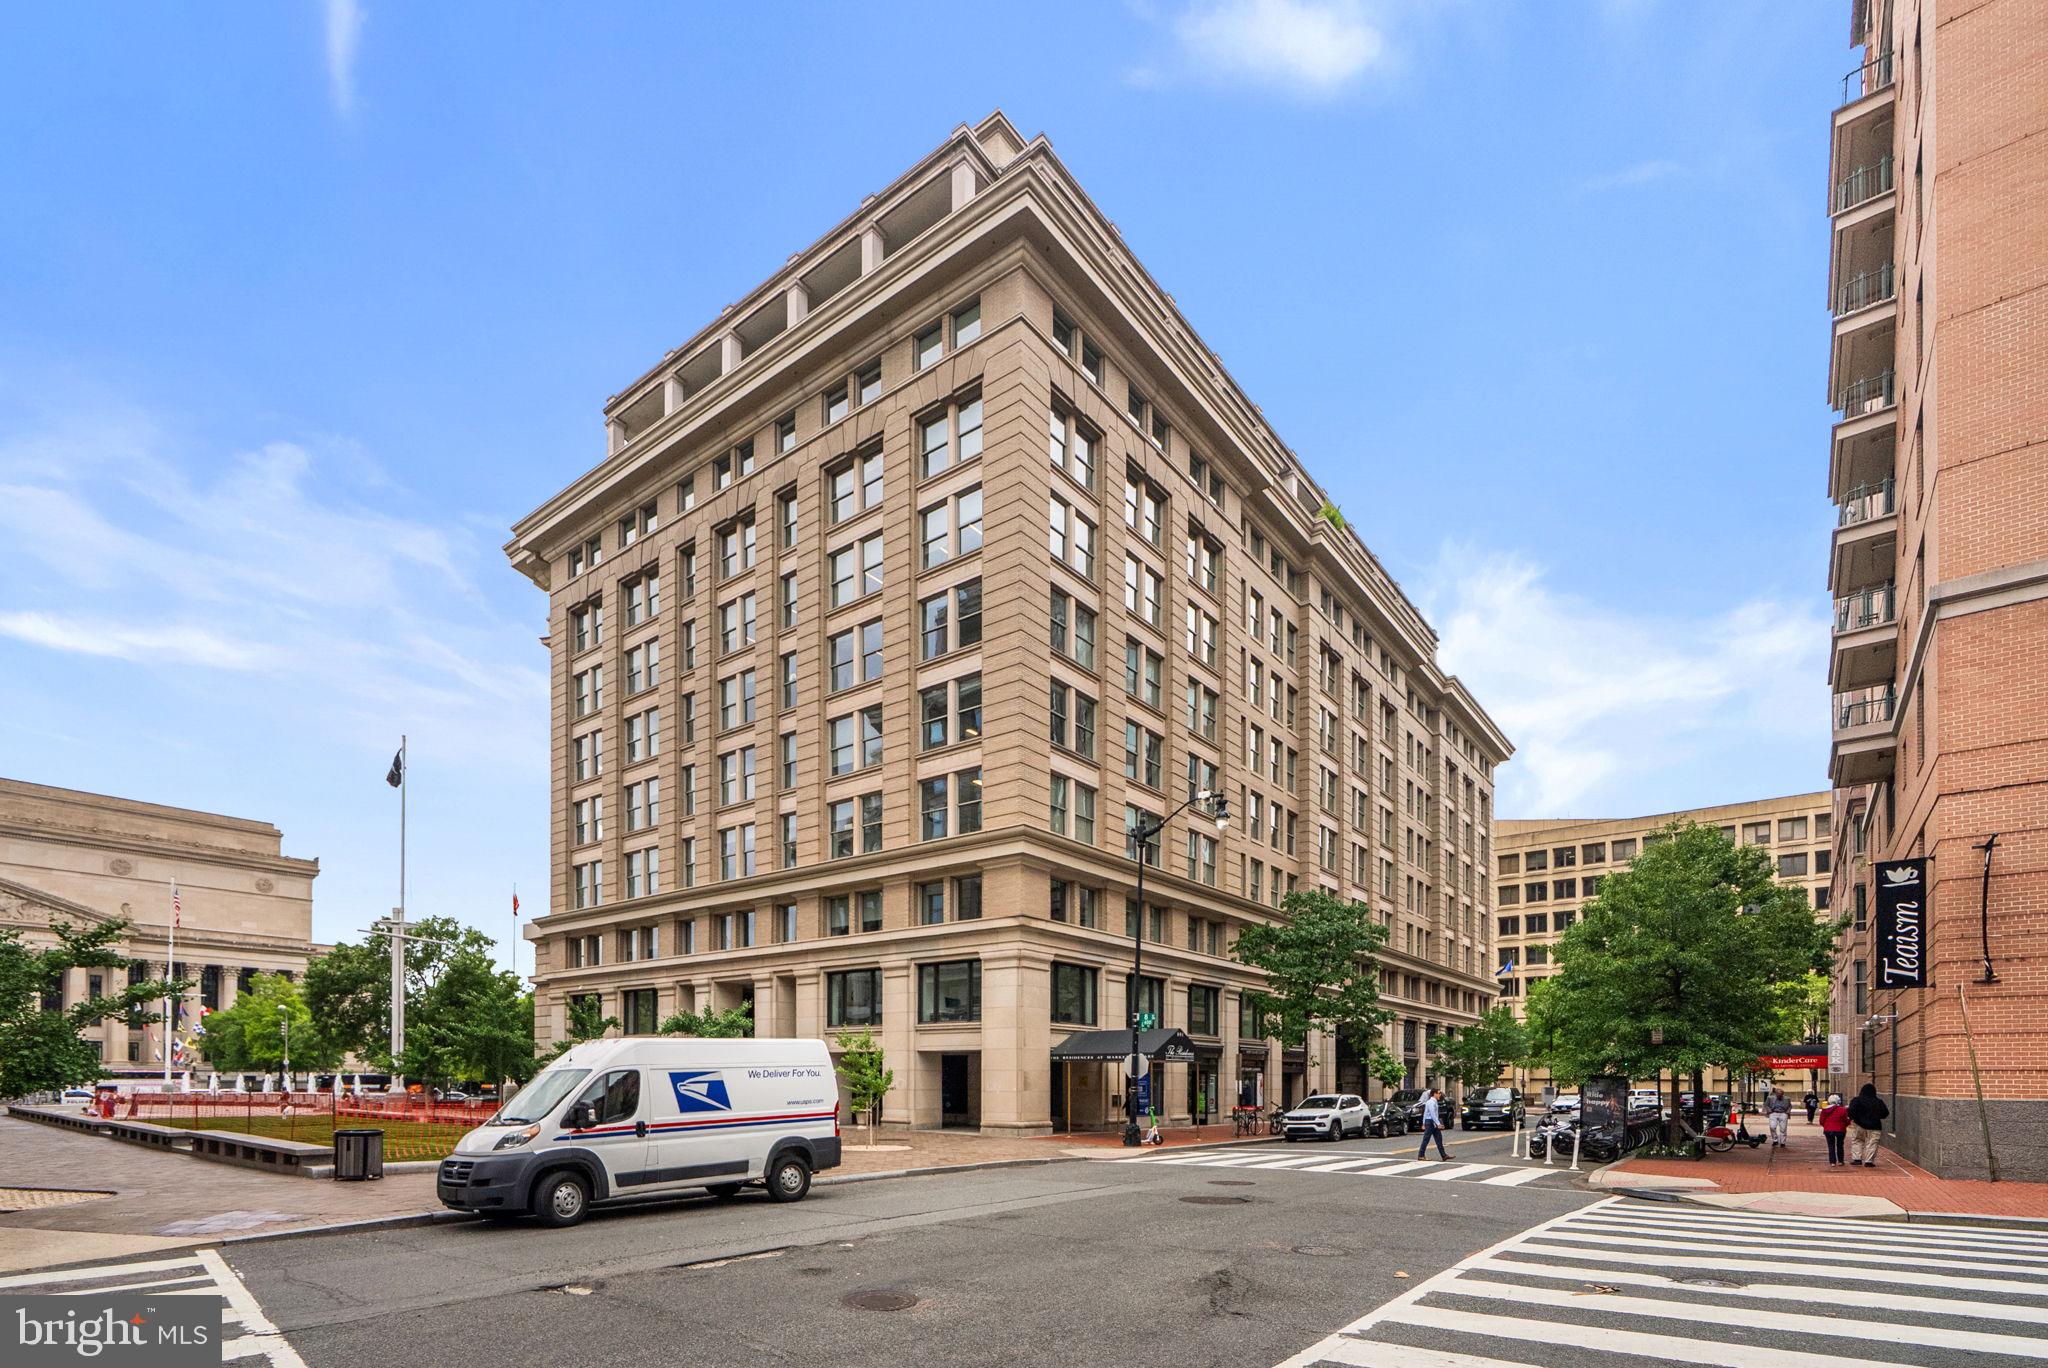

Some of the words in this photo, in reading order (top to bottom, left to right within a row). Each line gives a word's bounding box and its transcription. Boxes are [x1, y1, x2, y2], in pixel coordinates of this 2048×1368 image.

[1883, 901, 1918, 983] Teaism
[1165, 1045, 1176, 1055] The
[1831, 1034, 1842, 1065] PARK
[748, 1070, 761, 1078] We
[762, 1069, 790, 1078] Deliver
[792, 1069, 805, 1077] For
[805, 1069, 821, 1077] You.
[1586, 1099, 1610, 1107] happy
